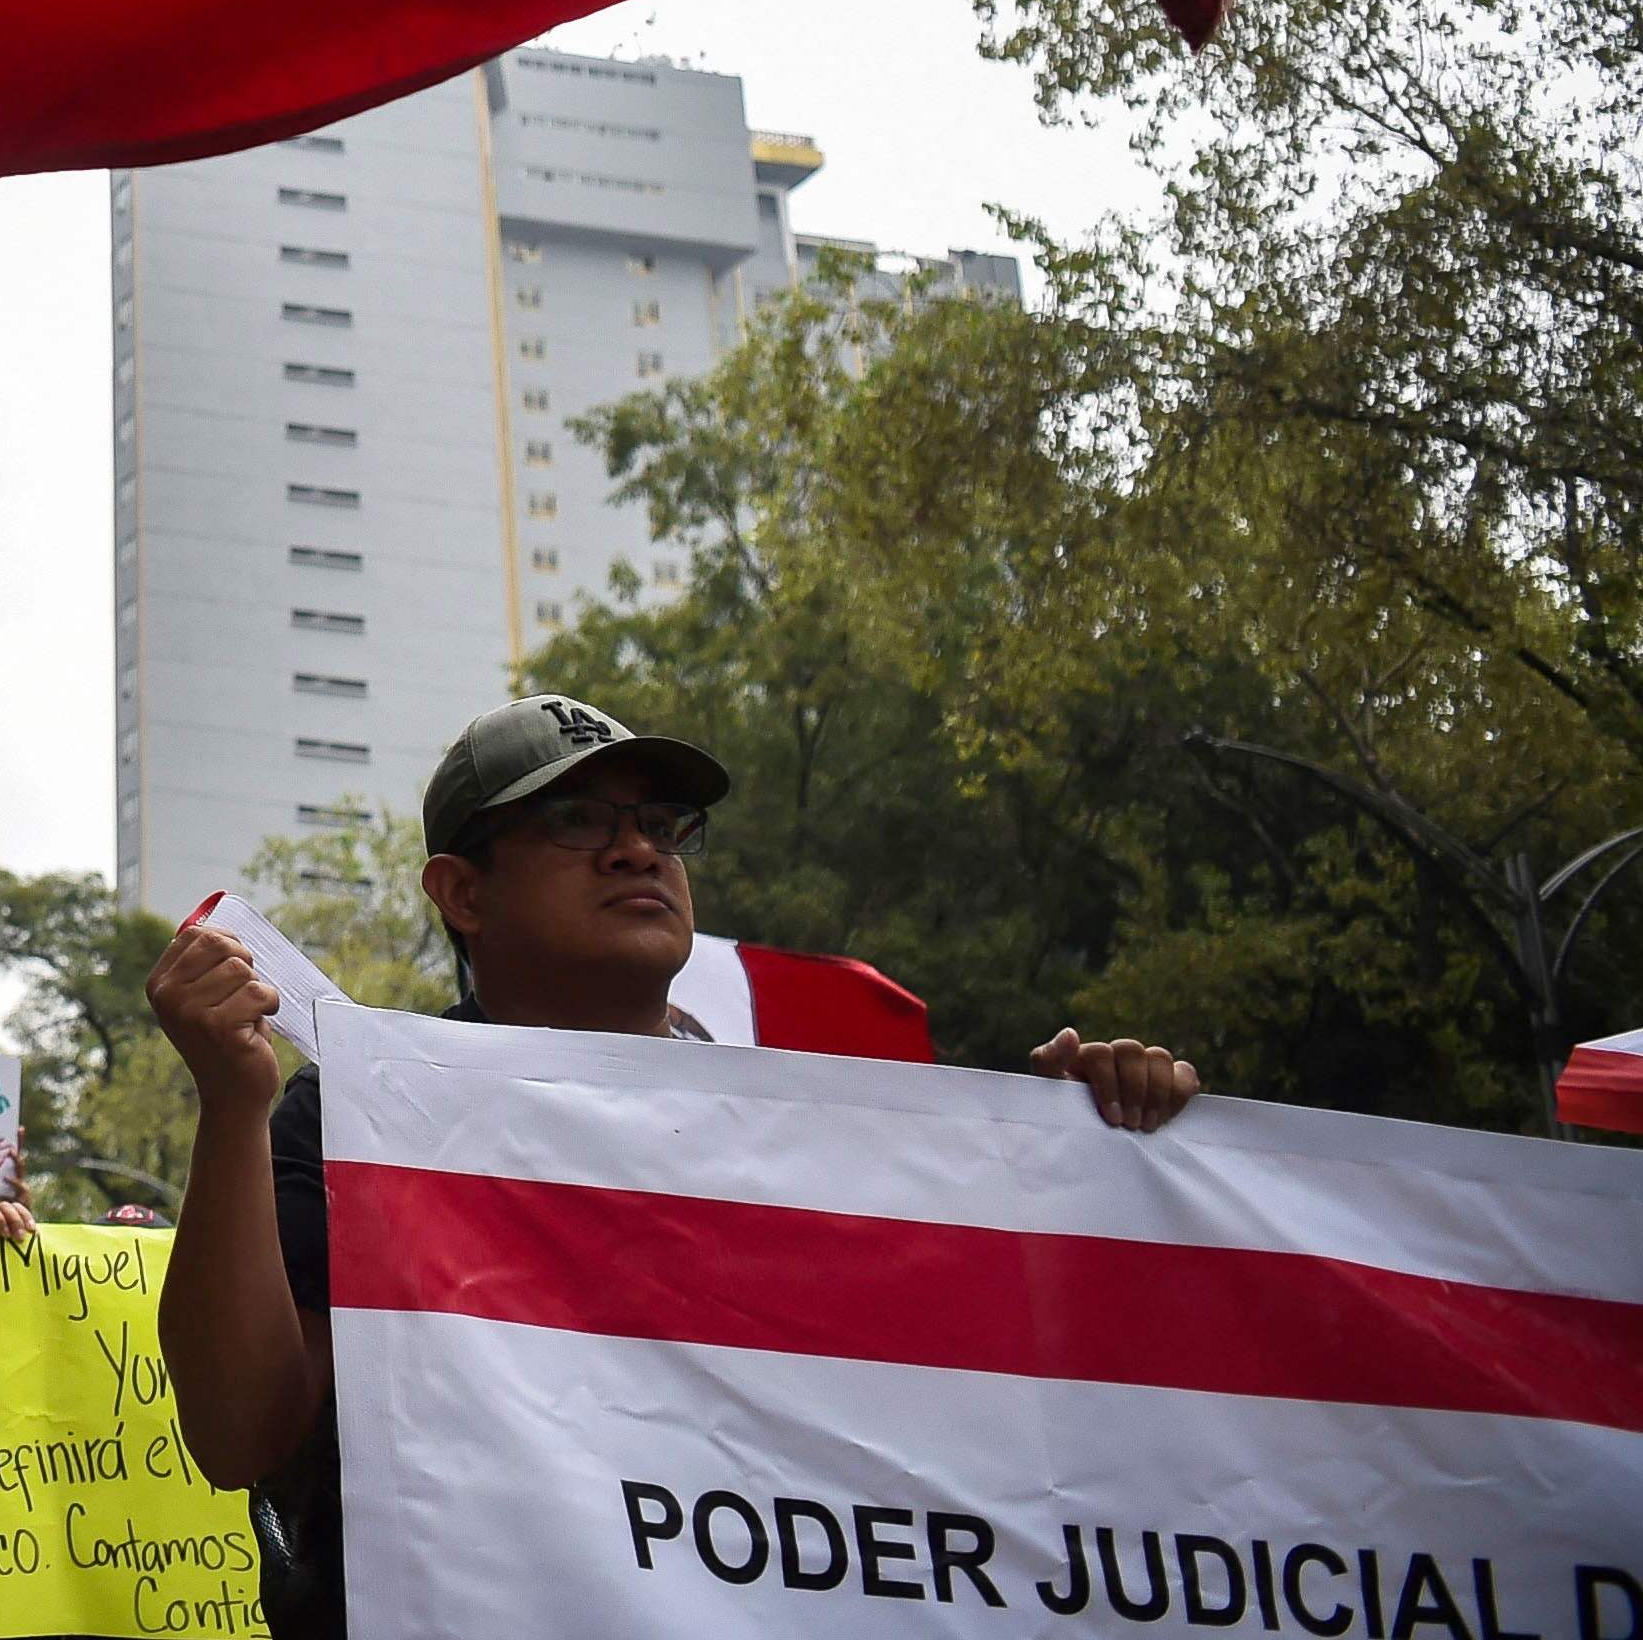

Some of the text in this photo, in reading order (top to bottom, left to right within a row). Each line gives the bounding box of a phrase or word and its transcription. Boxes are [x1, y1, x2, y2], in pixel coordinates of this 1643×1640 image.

[541, 700, 616, 744] LA
[0, 1230, 147, 1322] Miguel
[145, 1418, 193, 1486] el
[621, 1479, 1008, 1609] PODER
[1035, 1524, 1541, 1640] JUDICIAL
